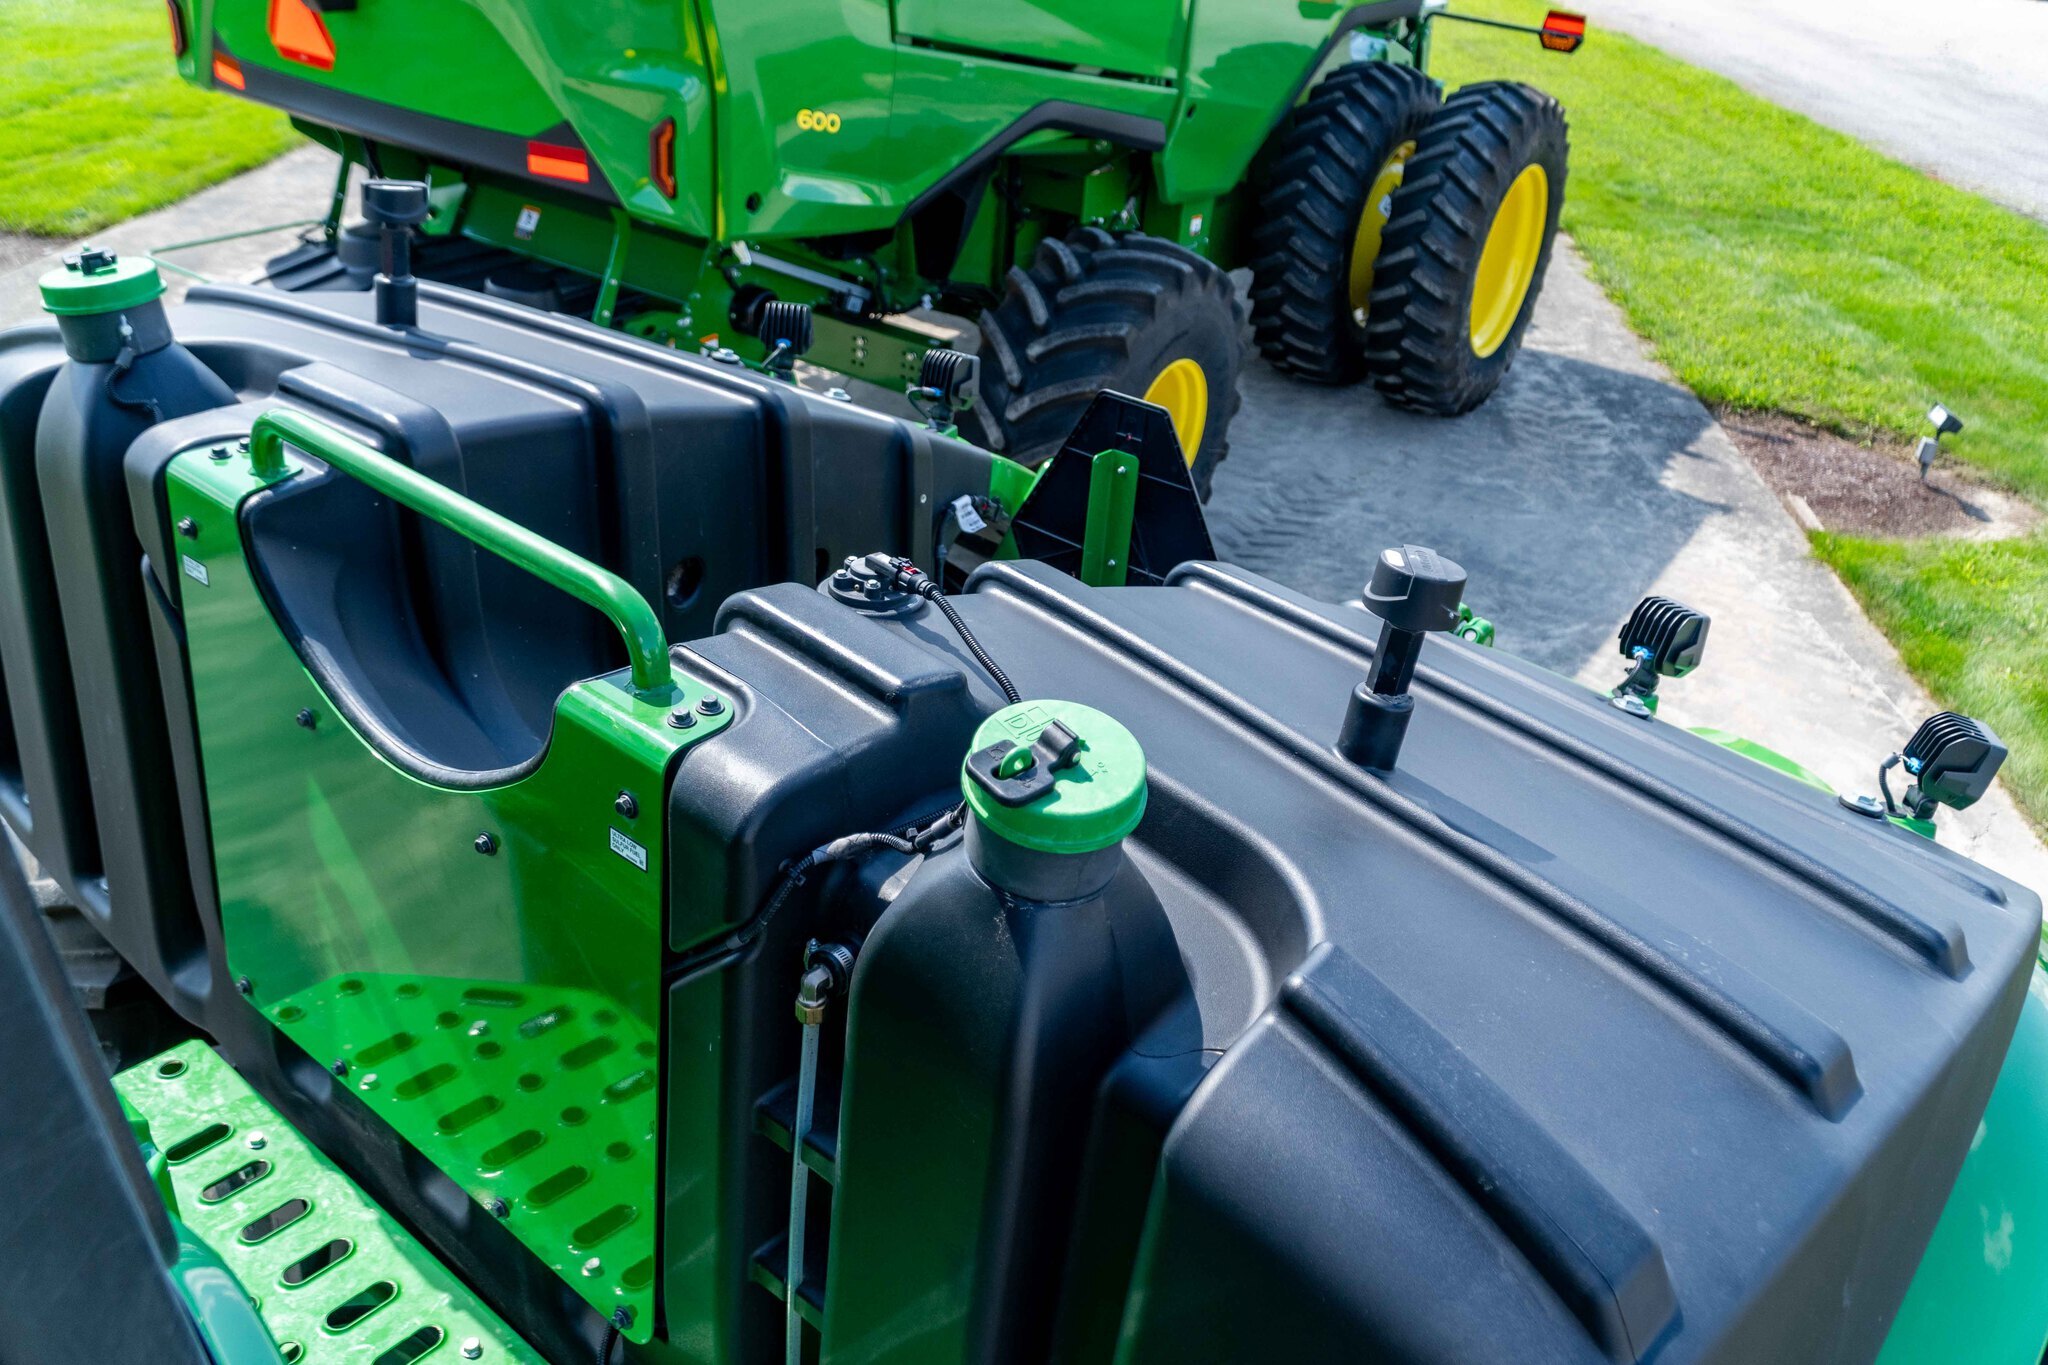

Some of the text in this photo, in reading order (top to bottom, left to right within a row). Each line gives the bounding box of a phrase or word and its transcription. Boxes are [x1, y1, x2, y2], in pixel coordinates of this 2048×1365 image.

[796, 108, 841, 134] 600
[612, 830, 637, 851] ULTRA LOW
